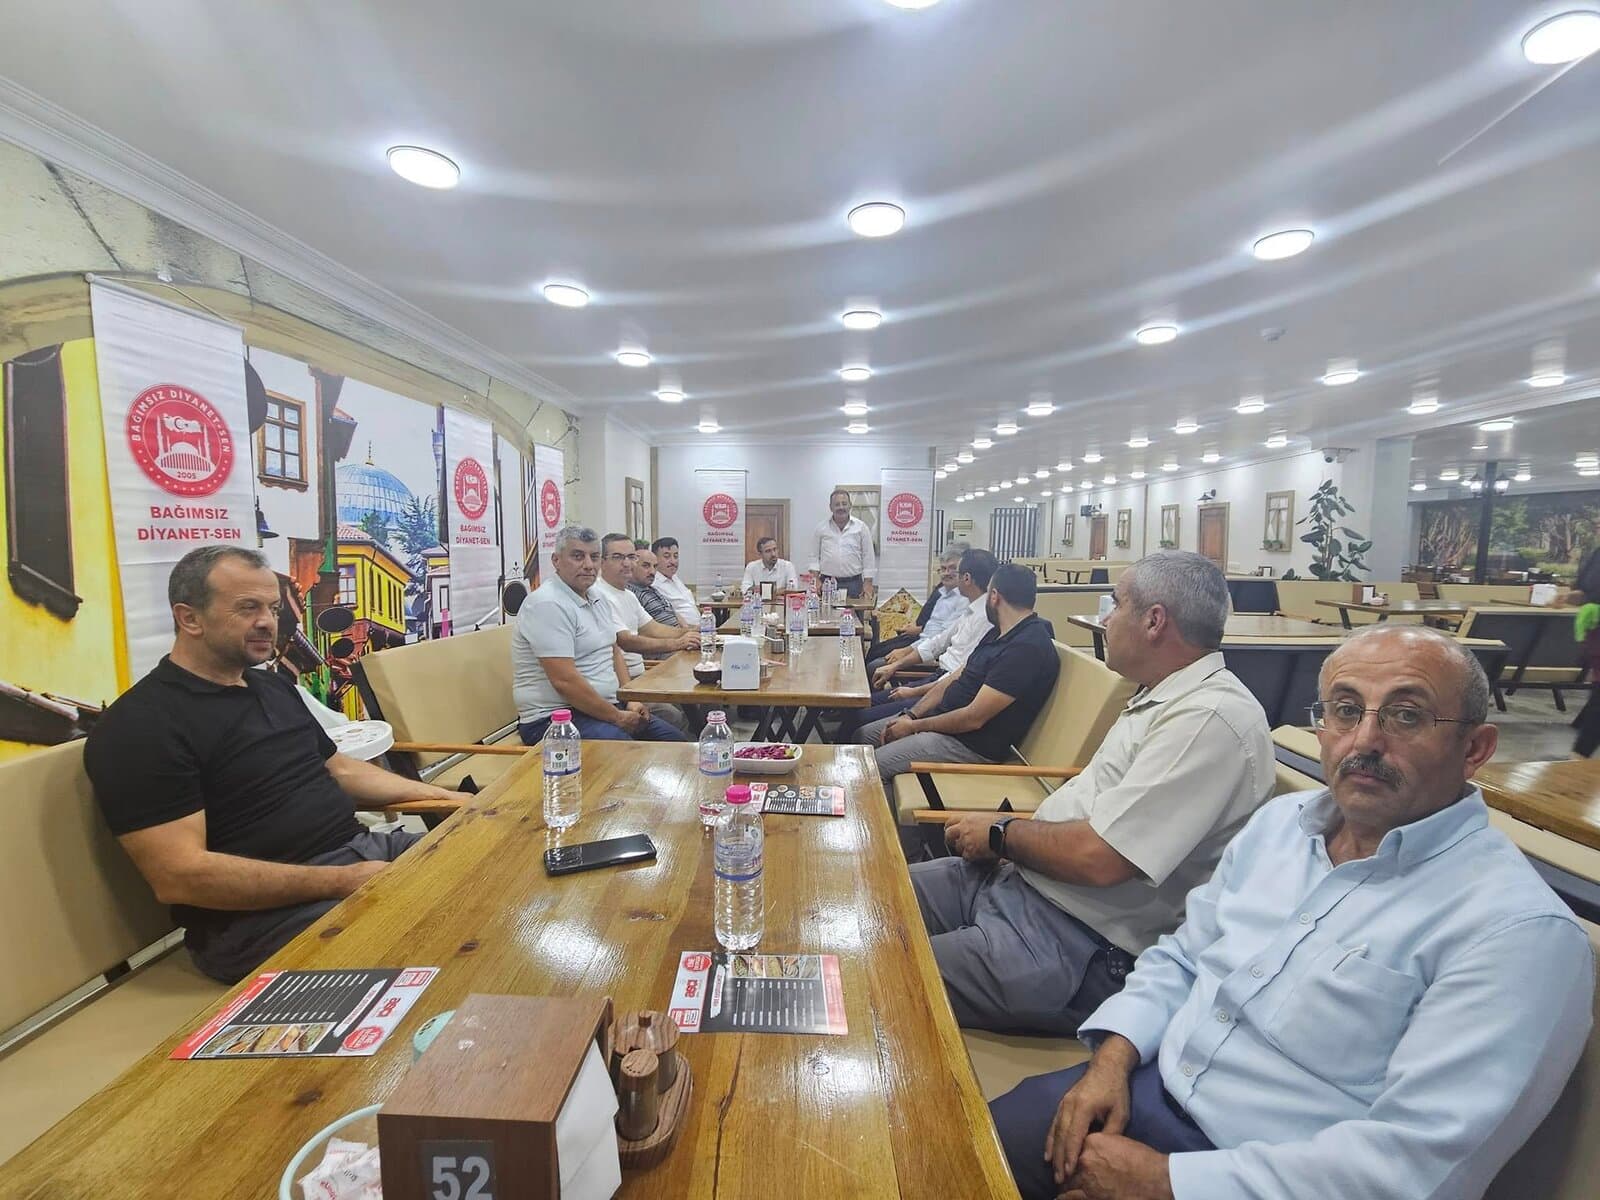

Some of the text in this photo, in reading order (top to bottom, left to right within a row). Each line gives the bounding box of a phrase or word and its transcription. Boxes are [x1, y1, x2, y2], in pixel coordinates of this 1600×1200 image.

[170, 390, 230, 453] DİYANET-SEN
[177, 471, 197, 480] 2005
[150, 505, 228, 519] BAĞIMSIZ
[137, 525, 240, 540] DİYANET-SEN
[432, 1156, 493, 1200] 52
